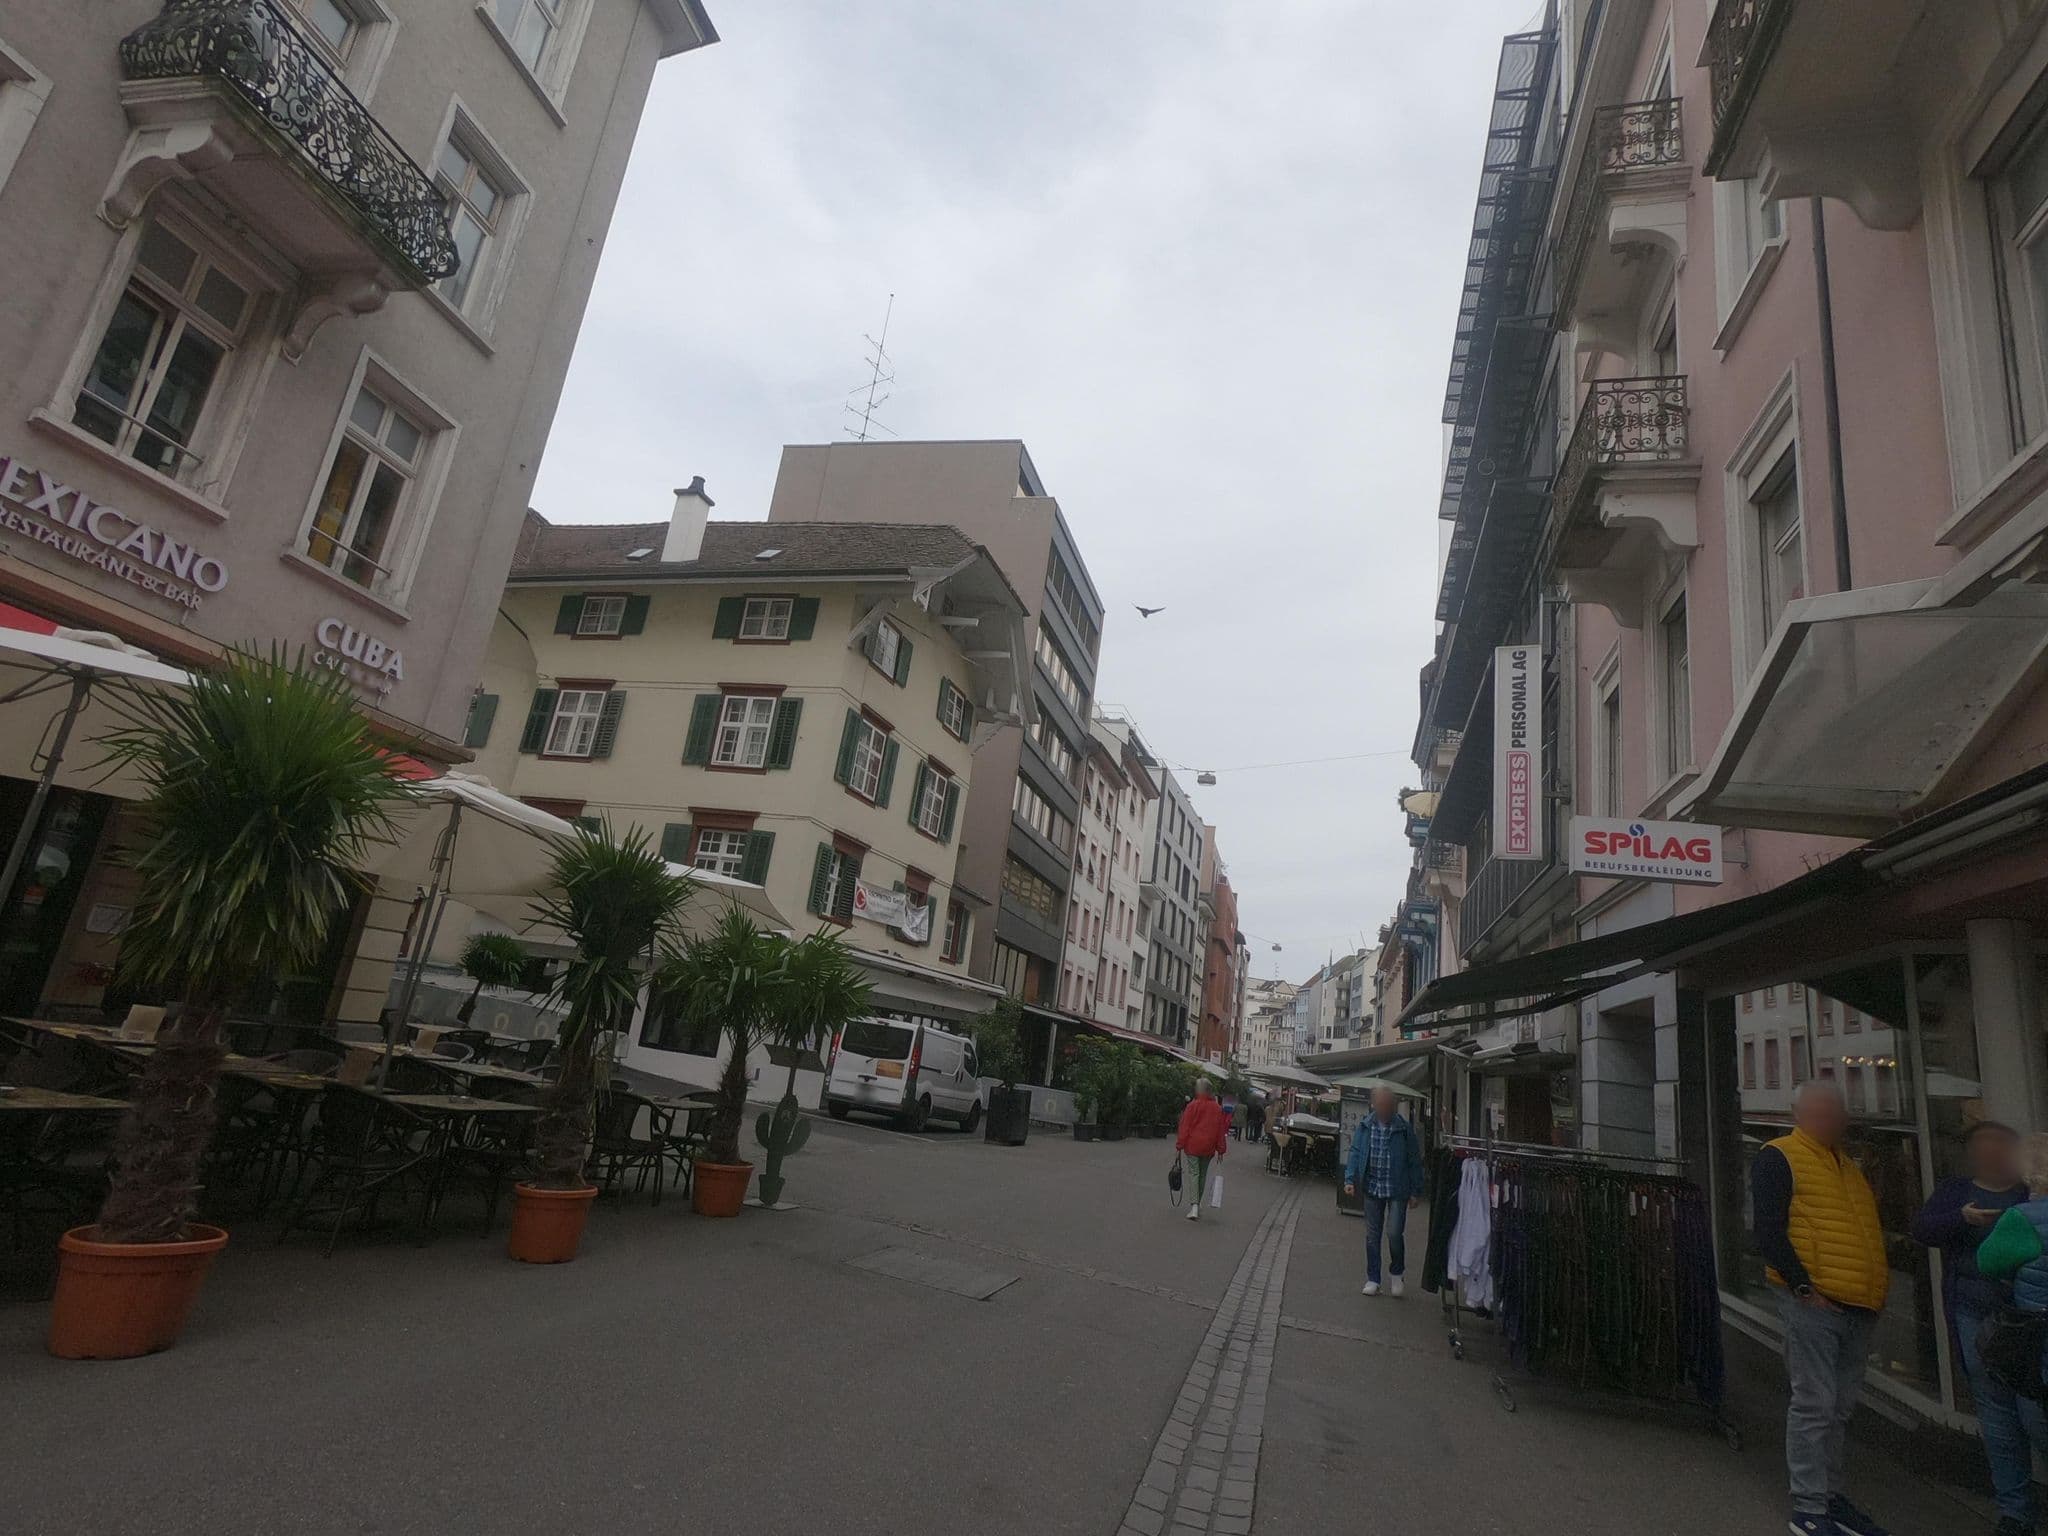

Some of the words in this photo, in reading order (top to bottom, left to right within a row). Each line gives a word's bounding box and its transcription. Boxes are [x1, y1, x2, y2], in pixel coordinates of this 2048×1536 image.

[142, 574, 165, 594] &
[164, 581, 203, 611] BAR
[318, 617, 404, 681] CUBA
[1511, 650, 1527, 671] AG
[1511, 673, 1527, 748] PERSONAL
[1511, 754, 1527, 850] EXPRESS
[1585, 860, 1712, 878] BERUFSBEKLEIDUNG
